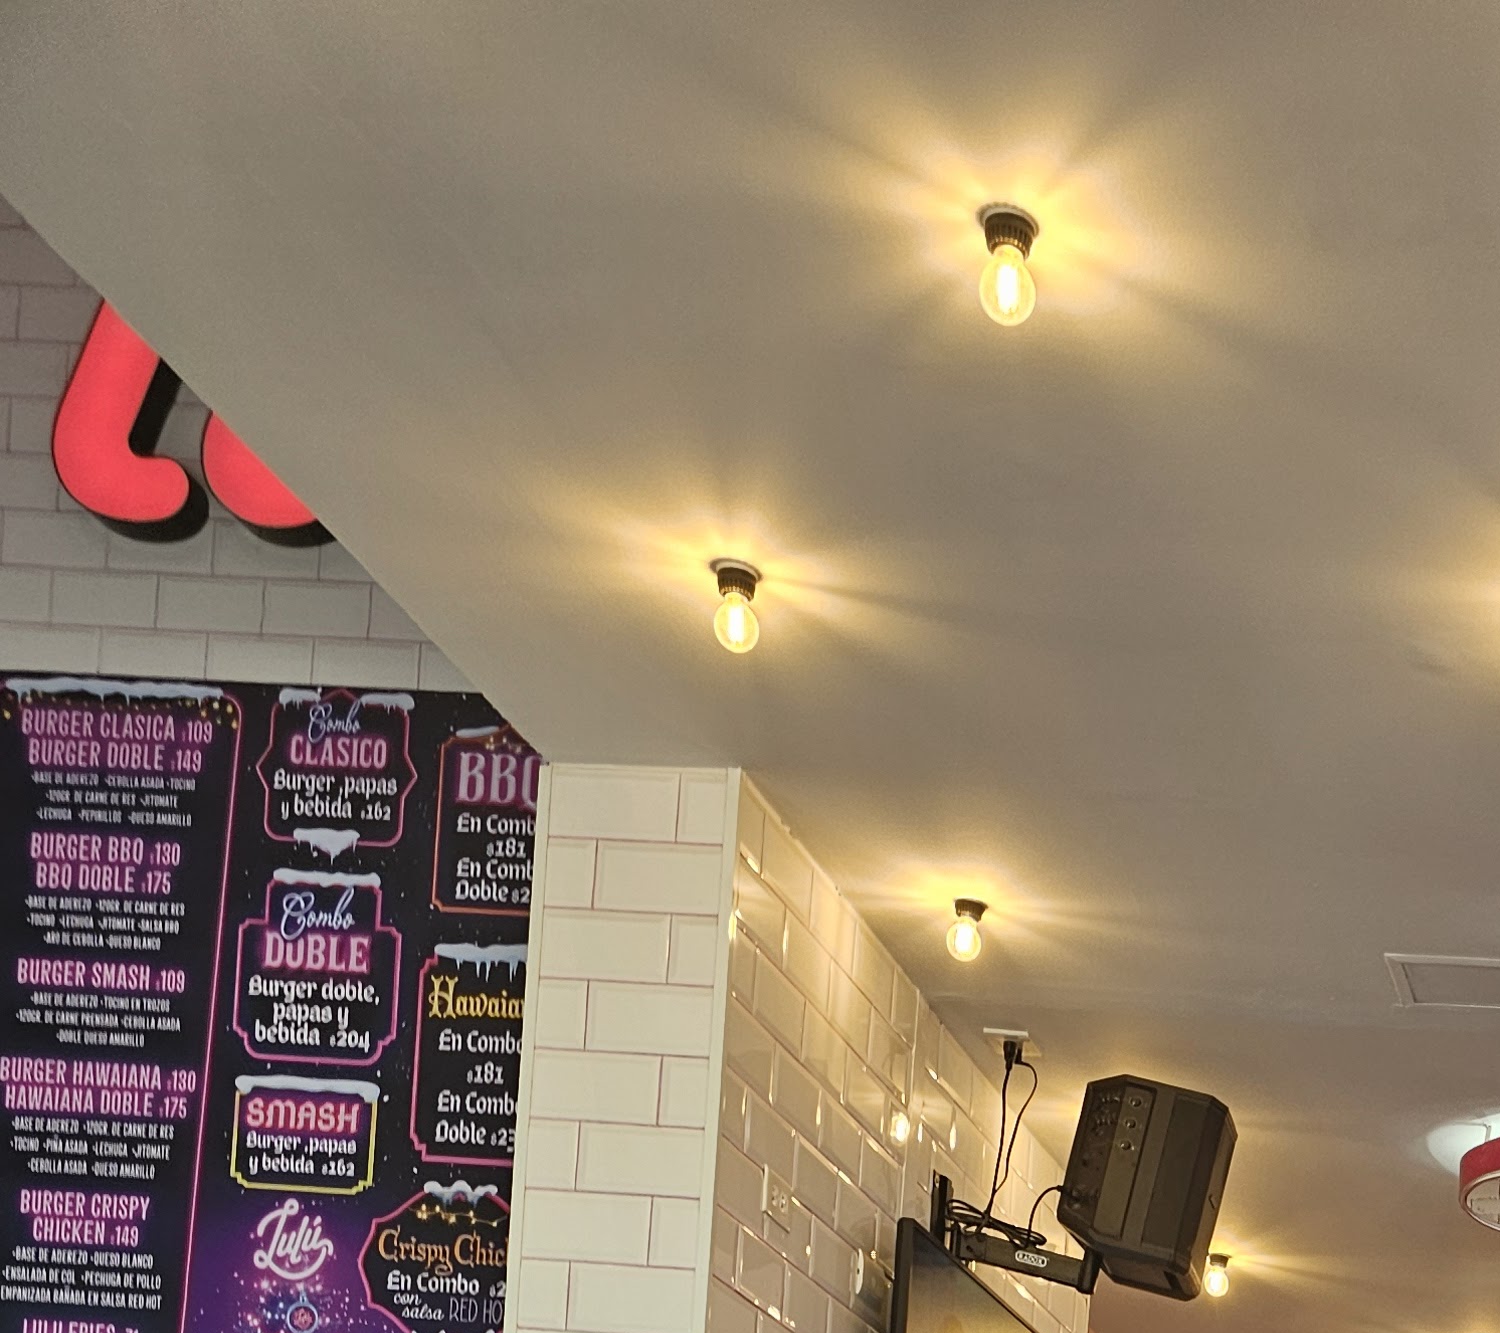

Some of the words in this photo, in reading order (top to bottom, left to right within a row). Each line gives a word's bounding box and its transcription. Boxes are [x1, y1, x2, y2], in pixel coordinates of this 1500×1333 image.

[22, 709, 93, 737] BURGER
[101, 712, 175, 742] CLASICA
[308, 702, 361, 743] Combo
[29, 738, 100, 768] BURGER
[107, 742, 164, 771] DOBLE
[290, 734, 387, 769] CLASICO
[273, 768, 335, 797] Burger
[281, 801, 289, 820] y
[294, 793, 352, 818] bebida
[456, 812, 481, 833] En
[31, 832, 101, 861] BURGER
[108, 836, 144, 865] BBQ
[36, 862, 72, 890] BBQ
[79, 865, 135, 893] DOBLE
[456, 858, 481, 878] En
[455, 879, 508, 902] Doble
[281, 886, 355, 940] Combo
[263, 931, 371, 973] DOBLE
[18, 958, 86, 987] BURGER
[91, 962, 150, 991] SMASH
[249, 975, 317, 1003] Burger
[322, 977, 379, 1005] doble,
[273, 1003, 332, 1025] papas
[338, 1007, 349, 1029] y
[254, 1018, 320, 1045] bebida
[439, 1028, 462, 1051] En
[0, 1057, 67, 1084] BURGER
[73, 1061, 162, 1091] HAWAIANA
[5, 1085, 94, 1114] HAWAIANA
[100, 1089, 153, 1117] DOBLE
[246, 1097, 360, 1133] SMASH
[437, 1089, 460, 1112] En
[246, 1130, 301, 1154] Burger
[435, 1119, 486, 1145] Doble
[249, 1156, 258, 1175] y
[262, 1152, 314, 1174] bebida
[20, 1189, 86, 1217] BURGER
[91, 1193, 150, 1221] CRISPY
[33, 1216, 105, 1245] CHICKEN
[379, 1225, 453, 1276] Crispy
[454, 1230, 508, 1268] Chic
[387, 1269, 411, 1291] En
[417, 1272, 479, 1295] Combo
[394, 1293, 421, 1305] con
[402, 1304, 444, 1321] salsa
[449, 1298, 478, 1322] RED
[483, 1298, 504, 1324] HO
